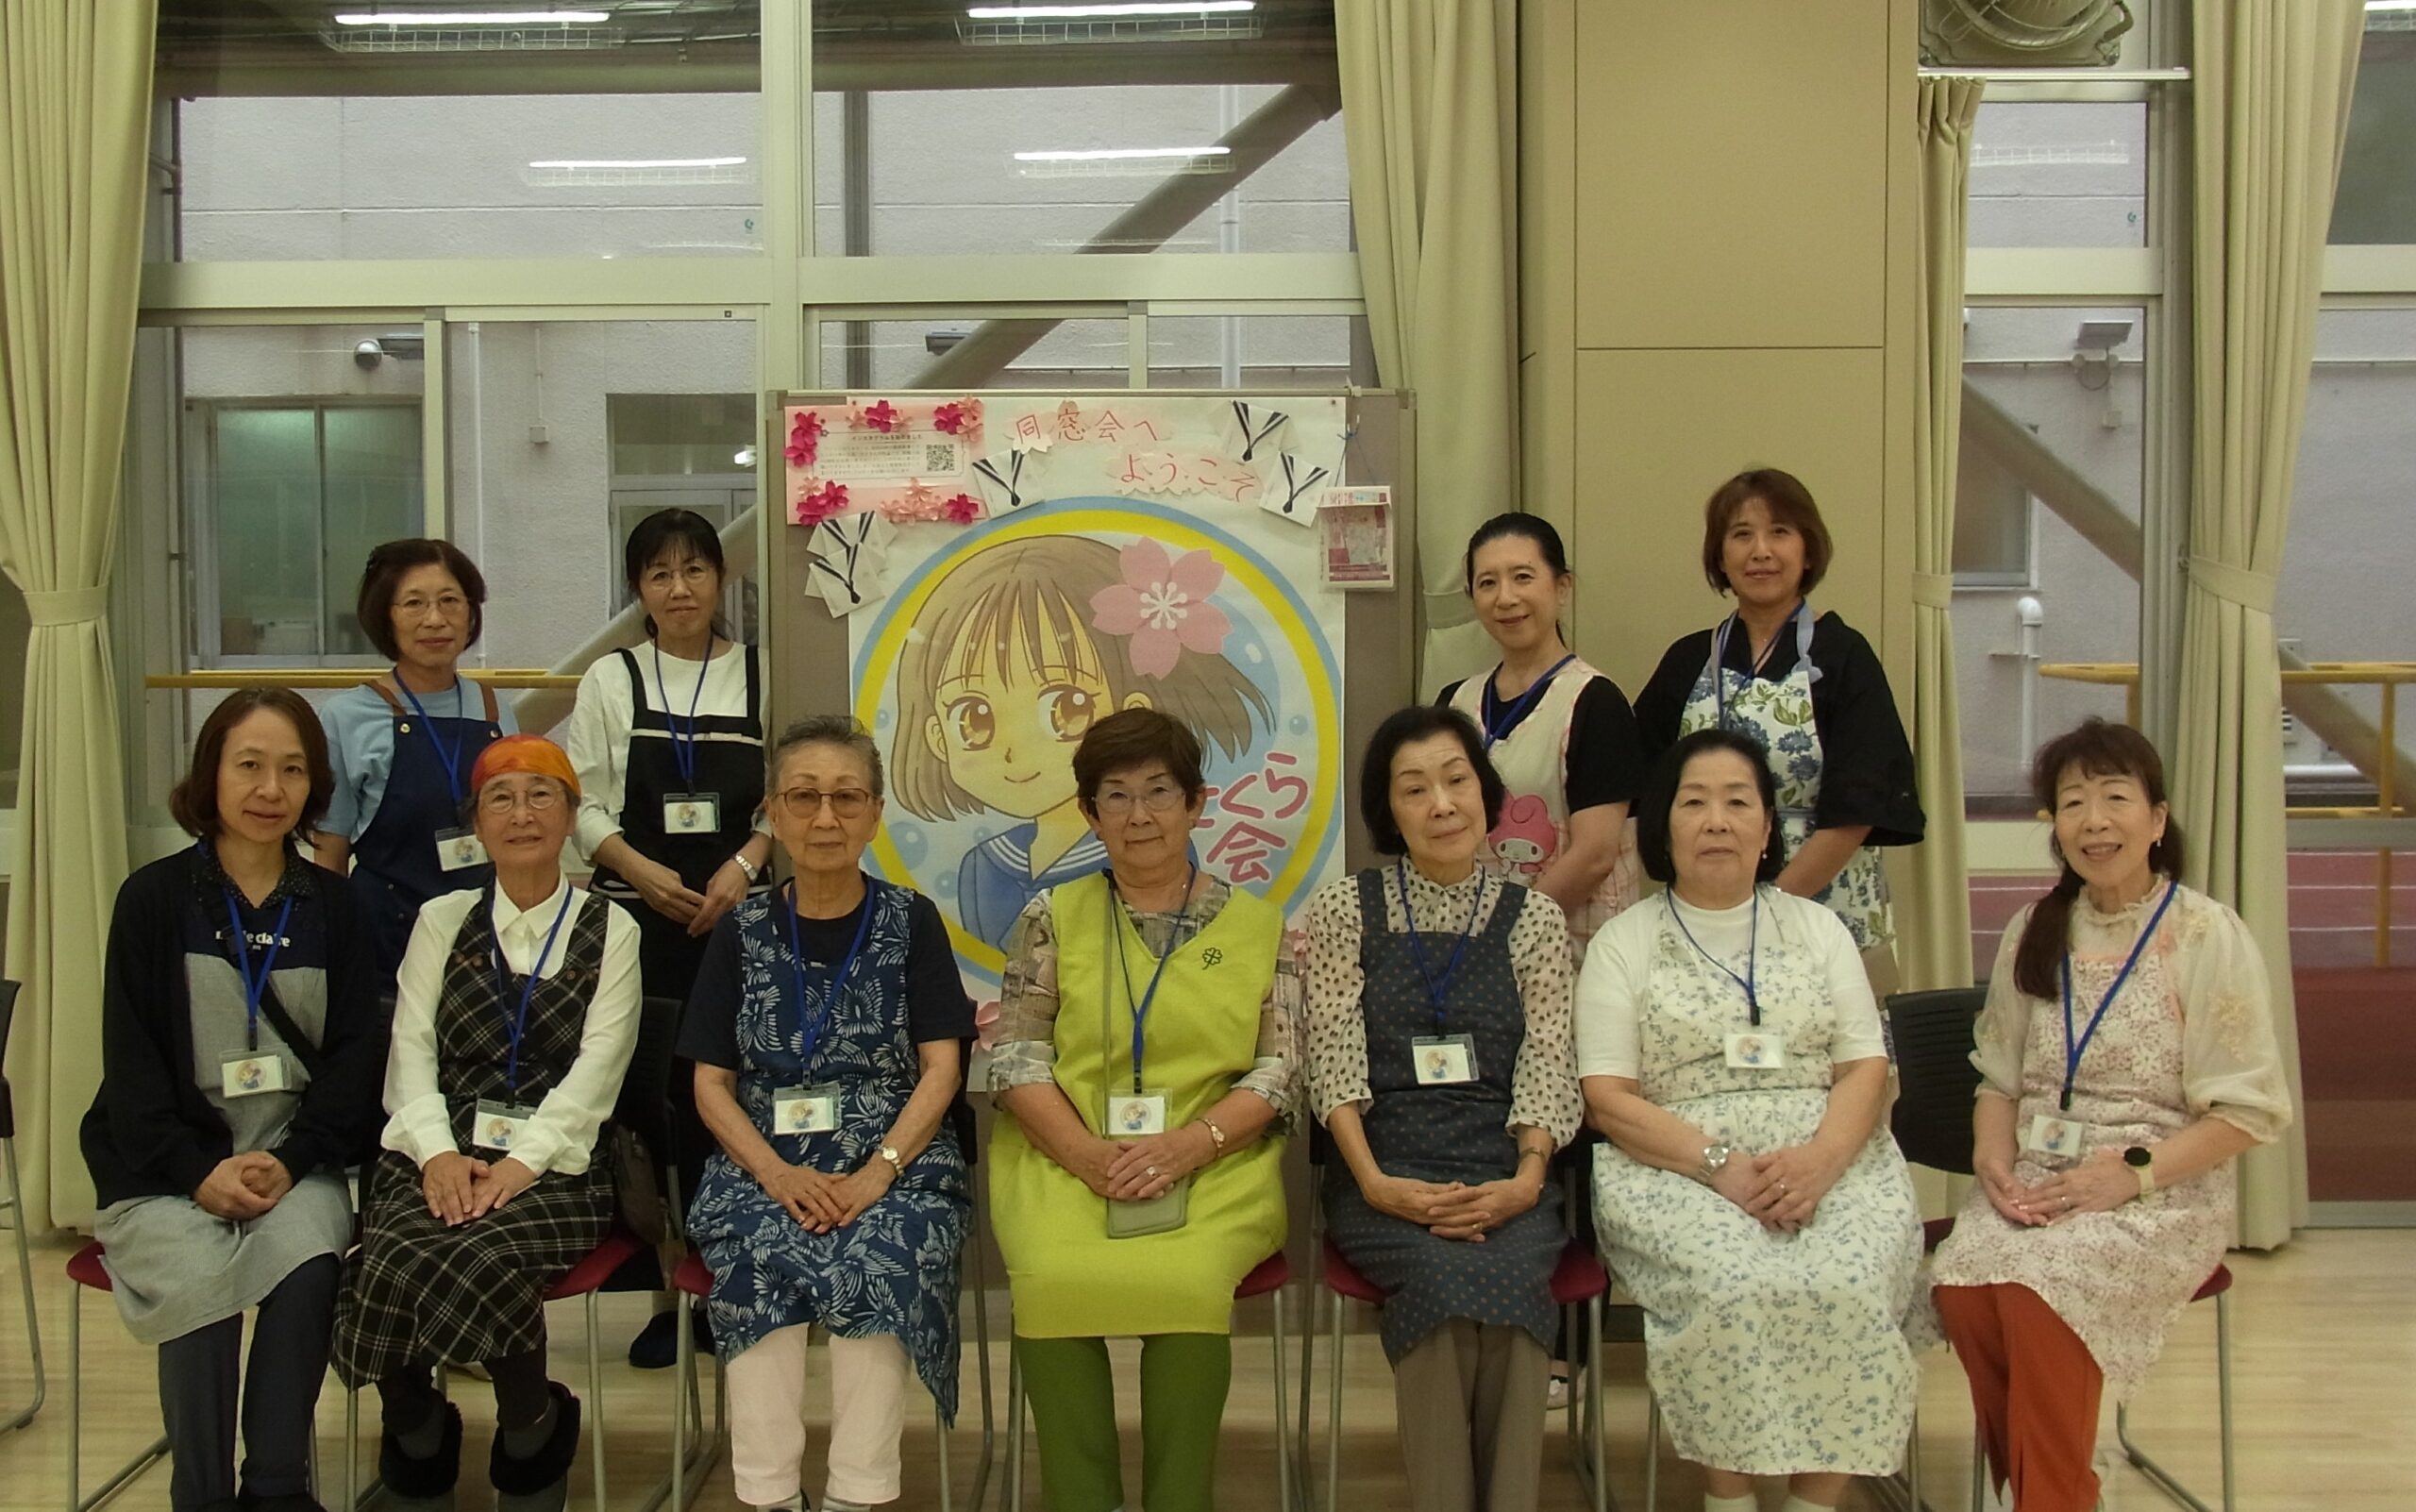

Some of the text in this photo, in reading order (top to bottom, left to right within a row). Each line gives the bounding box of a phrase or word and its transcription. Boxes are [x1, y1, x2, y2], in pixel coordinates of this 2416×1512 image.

[1015, 408, 1158, 444] 同窓会へ
[1120, 453, 1255, 502] ようこそ
[1196, 751, 1309, 829] くら
[1205, 820, 1287, 883] 会
[255, 932, 291, 948] clae
